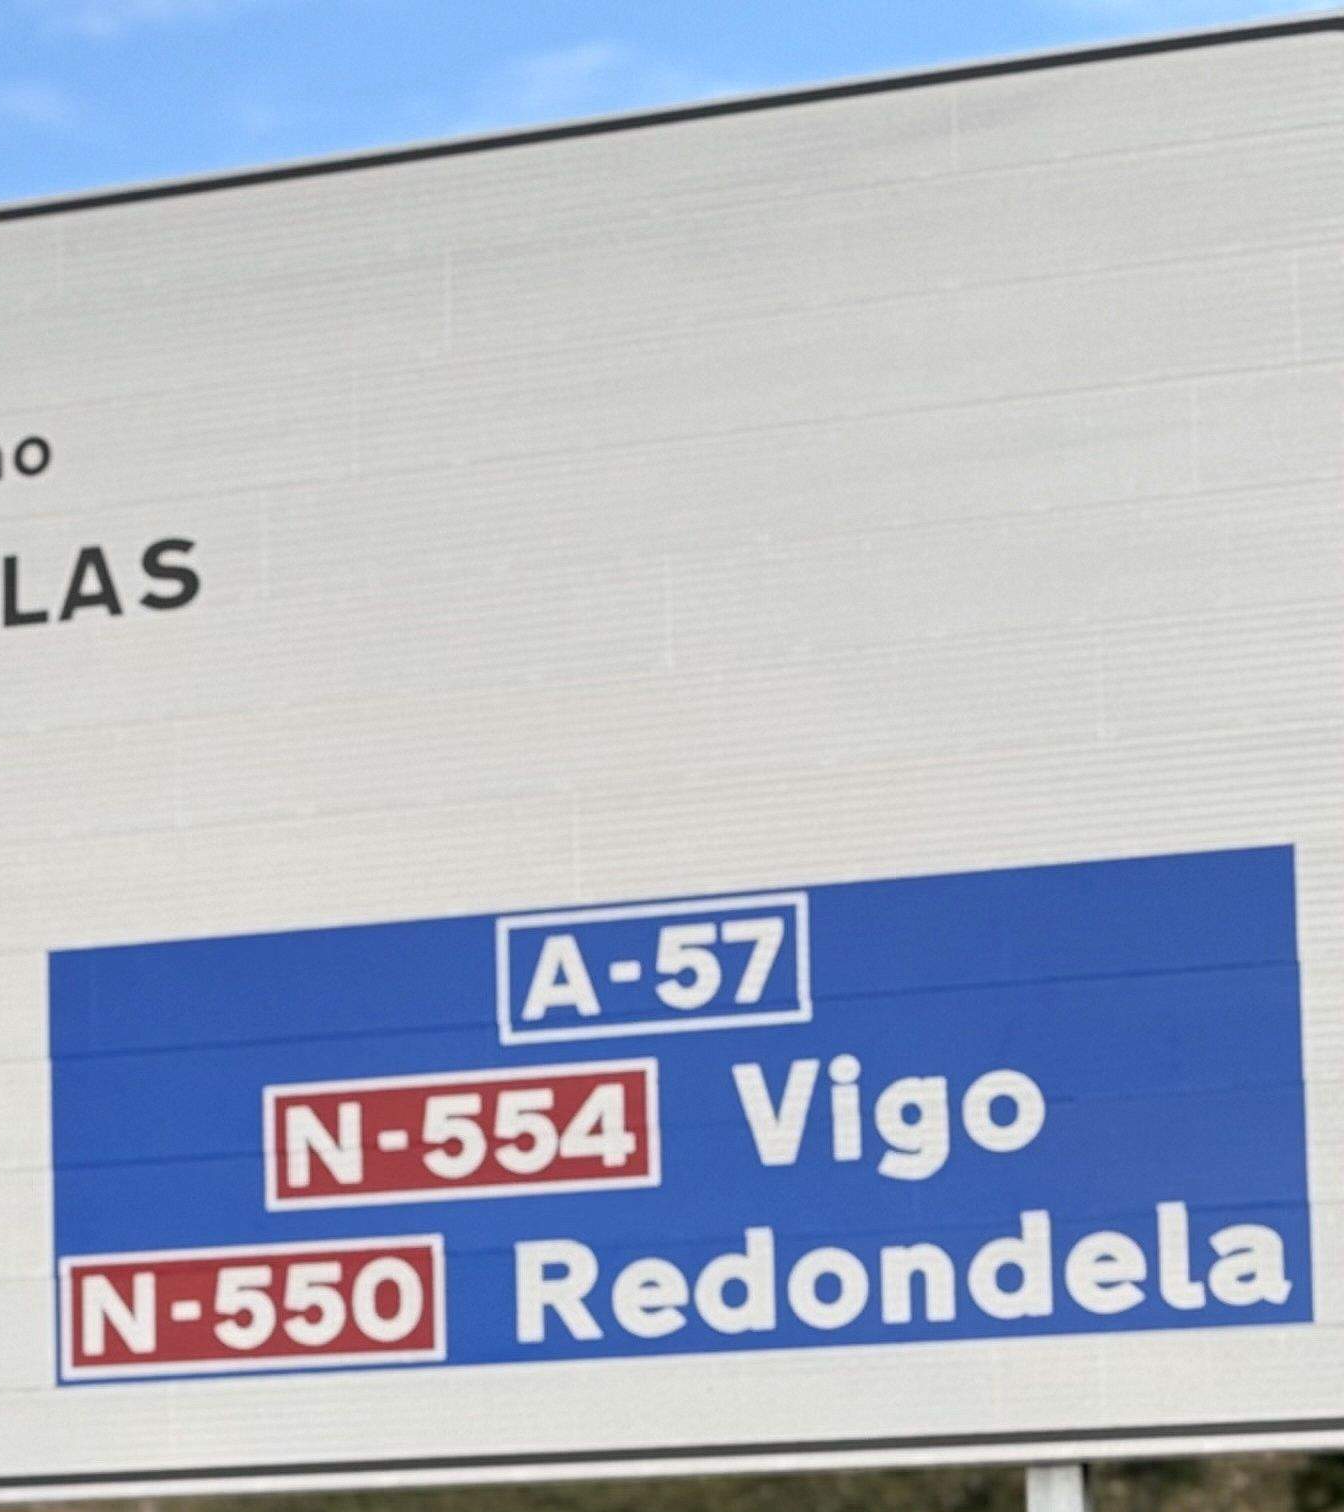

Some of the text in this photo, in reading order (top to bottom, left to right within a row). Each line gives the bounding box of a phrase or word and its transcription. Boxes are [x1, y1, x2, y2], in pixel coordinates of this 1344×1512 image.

[522, 917, 785, 1023] A-57
[285, 1054, 1045, 1187] N-554 Vigo
[81, 1201, 1291, 1357] N-550 Redondela
